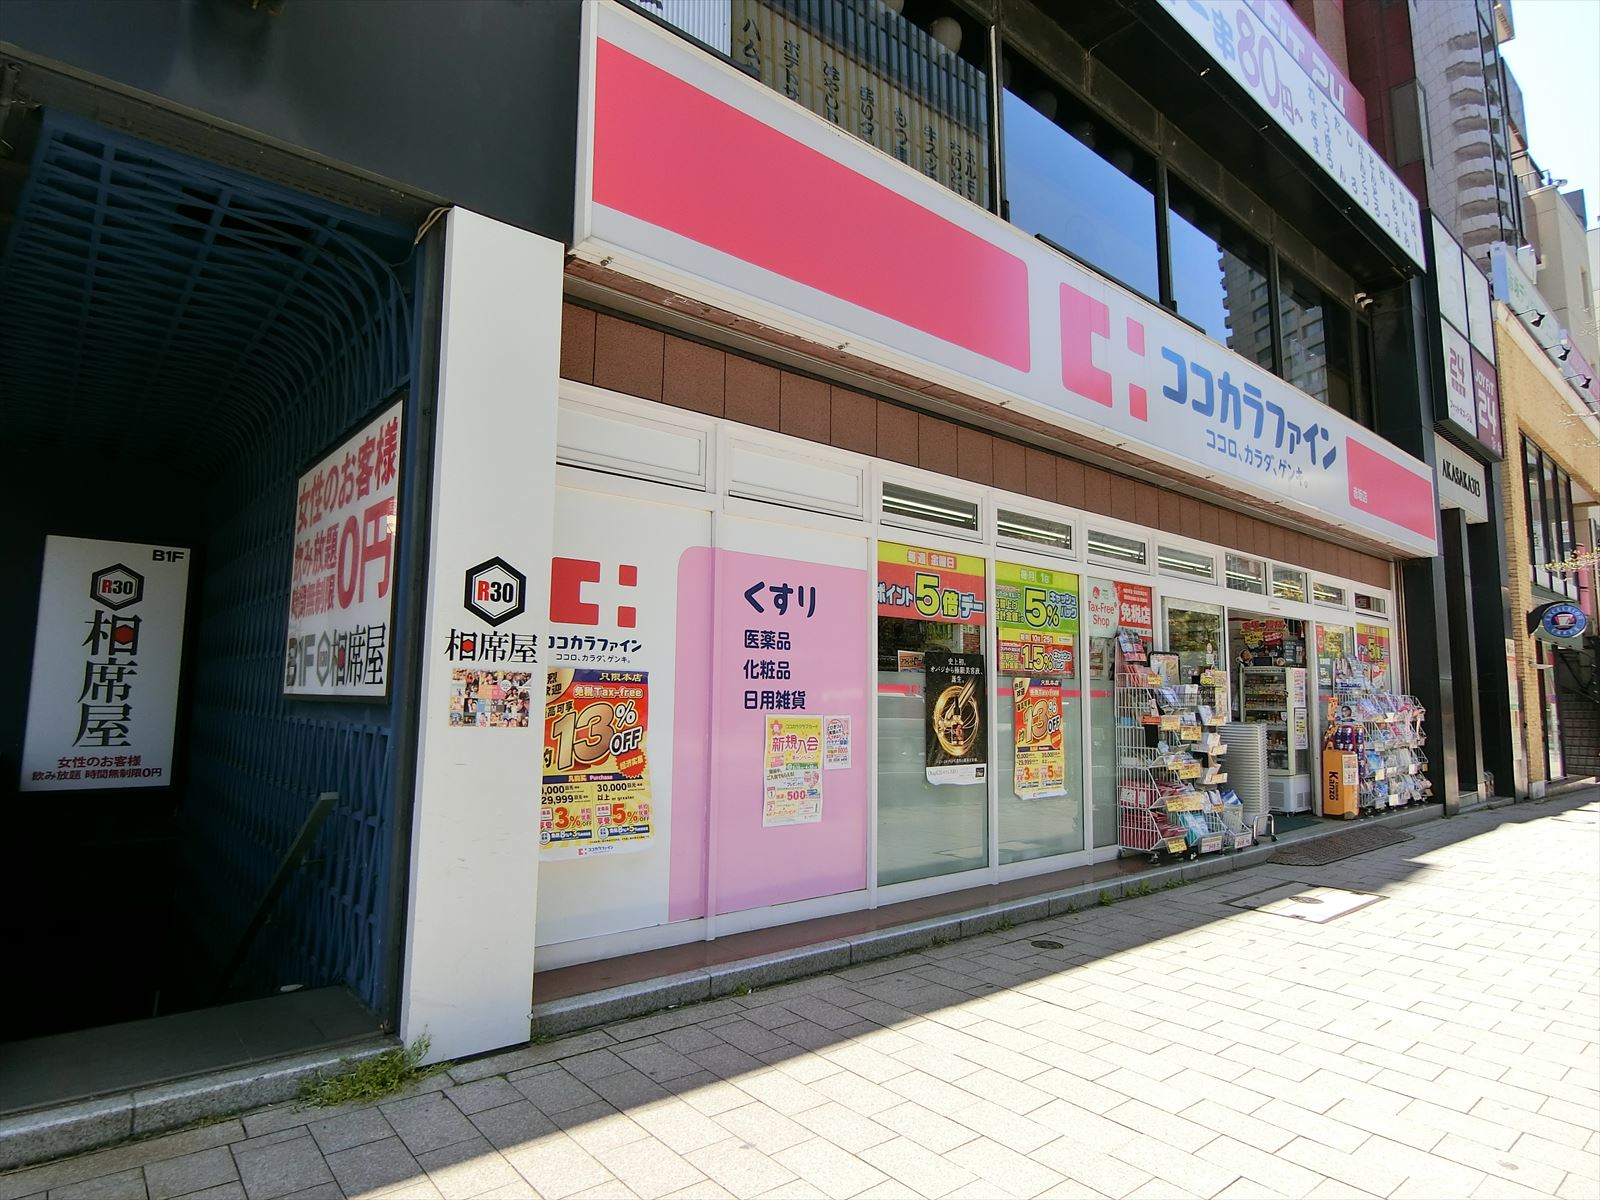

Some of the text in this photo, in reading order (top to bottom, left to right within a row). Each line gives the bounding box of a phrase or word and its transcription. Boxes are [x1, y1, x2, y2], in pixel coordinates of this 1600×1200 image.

[1475, 369, 1494, 396] JOYFIT
[1161, 345, 1337, 470] ココカラファイン
[1477, 388, 1497, 436] 24
[1206, 429, 1310, 490] ココロ、カラダ、ゲンキ。
[297, 416, 399, 536] 女性のお客様
[152, 549, 185, 563] B1F
[293, 522, 339, 582] 飲み放題
[337, 495, 397, 609] 0円
[101, 579, 134, 595] R30
[291, 574, 336, 621] 時間無制限
[477, 580, 514, 604] R30
[744, 581, 816, 618] くすり
[1024, 587, 1060, 629] 5%
[1048, 590, 1078, 607] キャッシュ
[1088, 600, 1115, 615] Tax-Free
[1092, 614, 1110, 629] Shop
[444, 628, 539, 665] 相席屋
[744, 629, 791, 650] 医薬品
[286, 632, 316, 687] B1F
[331, 621, 386, 687] 相席屋
[555, 652, 631, 664] ココロ、カラダ、ゲンキ。
[72, 609, 143, 748] 相席屋
[599, 672, 643, 682] 只限本店
[743, 659, 791, 680] 化粧品
[744, 690, 806, 710] 日用雑貨
[552, 700, 638, 771] 13%
[1048, 716, 1061, 733] OFF
[610, 726, 643, 755] OFF
[771, 734, 819, 754] 新規入会
[58, 755, 142, 769] 女性のお客様
[32, 767, 162, 781] 飲み放題 時間無制限0円
[597, 783, 627, 792] 30,000
[786, 790, 806, 801] 500
[542, 795, 574, 805] 29,999
[555, 806, 581, 829] 3%
[612, 803, 637, 824] 5%
